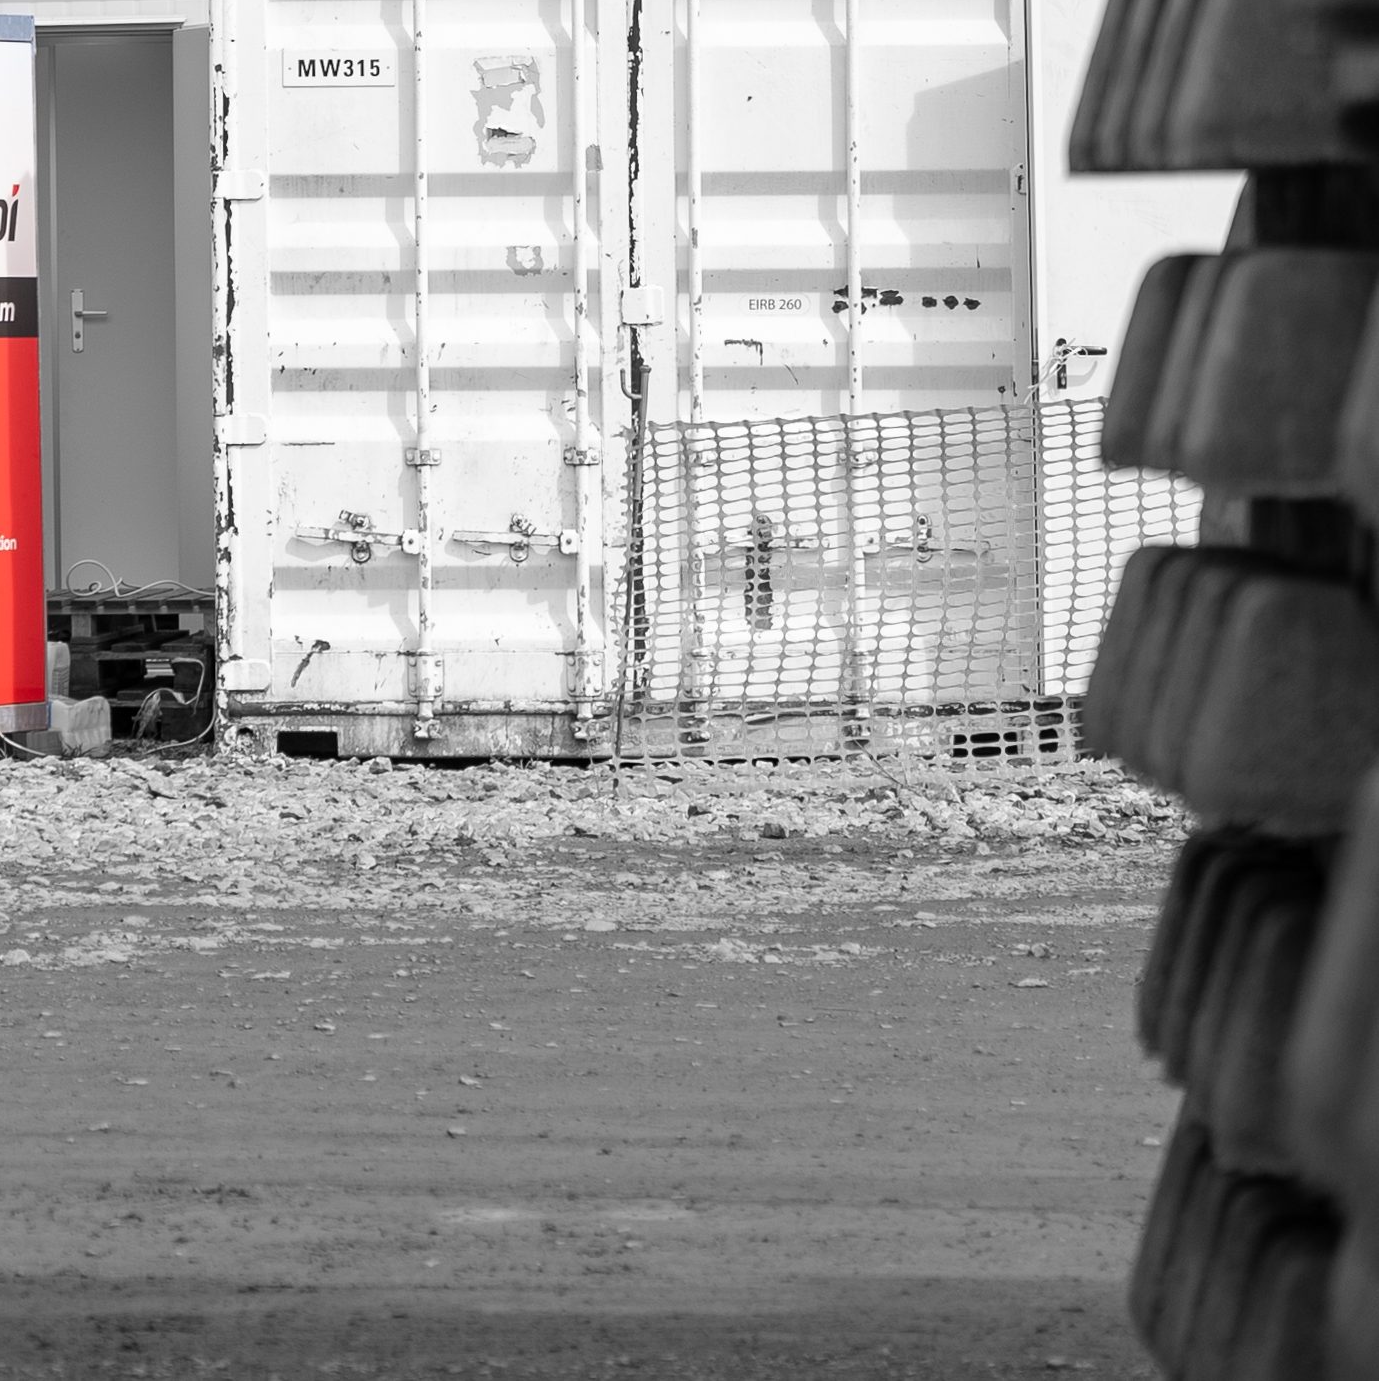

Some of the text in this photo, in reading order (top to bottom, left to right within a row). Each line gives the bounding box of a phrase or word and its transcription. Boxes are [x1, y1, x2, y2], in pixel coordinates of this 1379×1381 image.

[297, 58, 381, 78] MW315
[748, 298, 802, 311] EIRB 260
